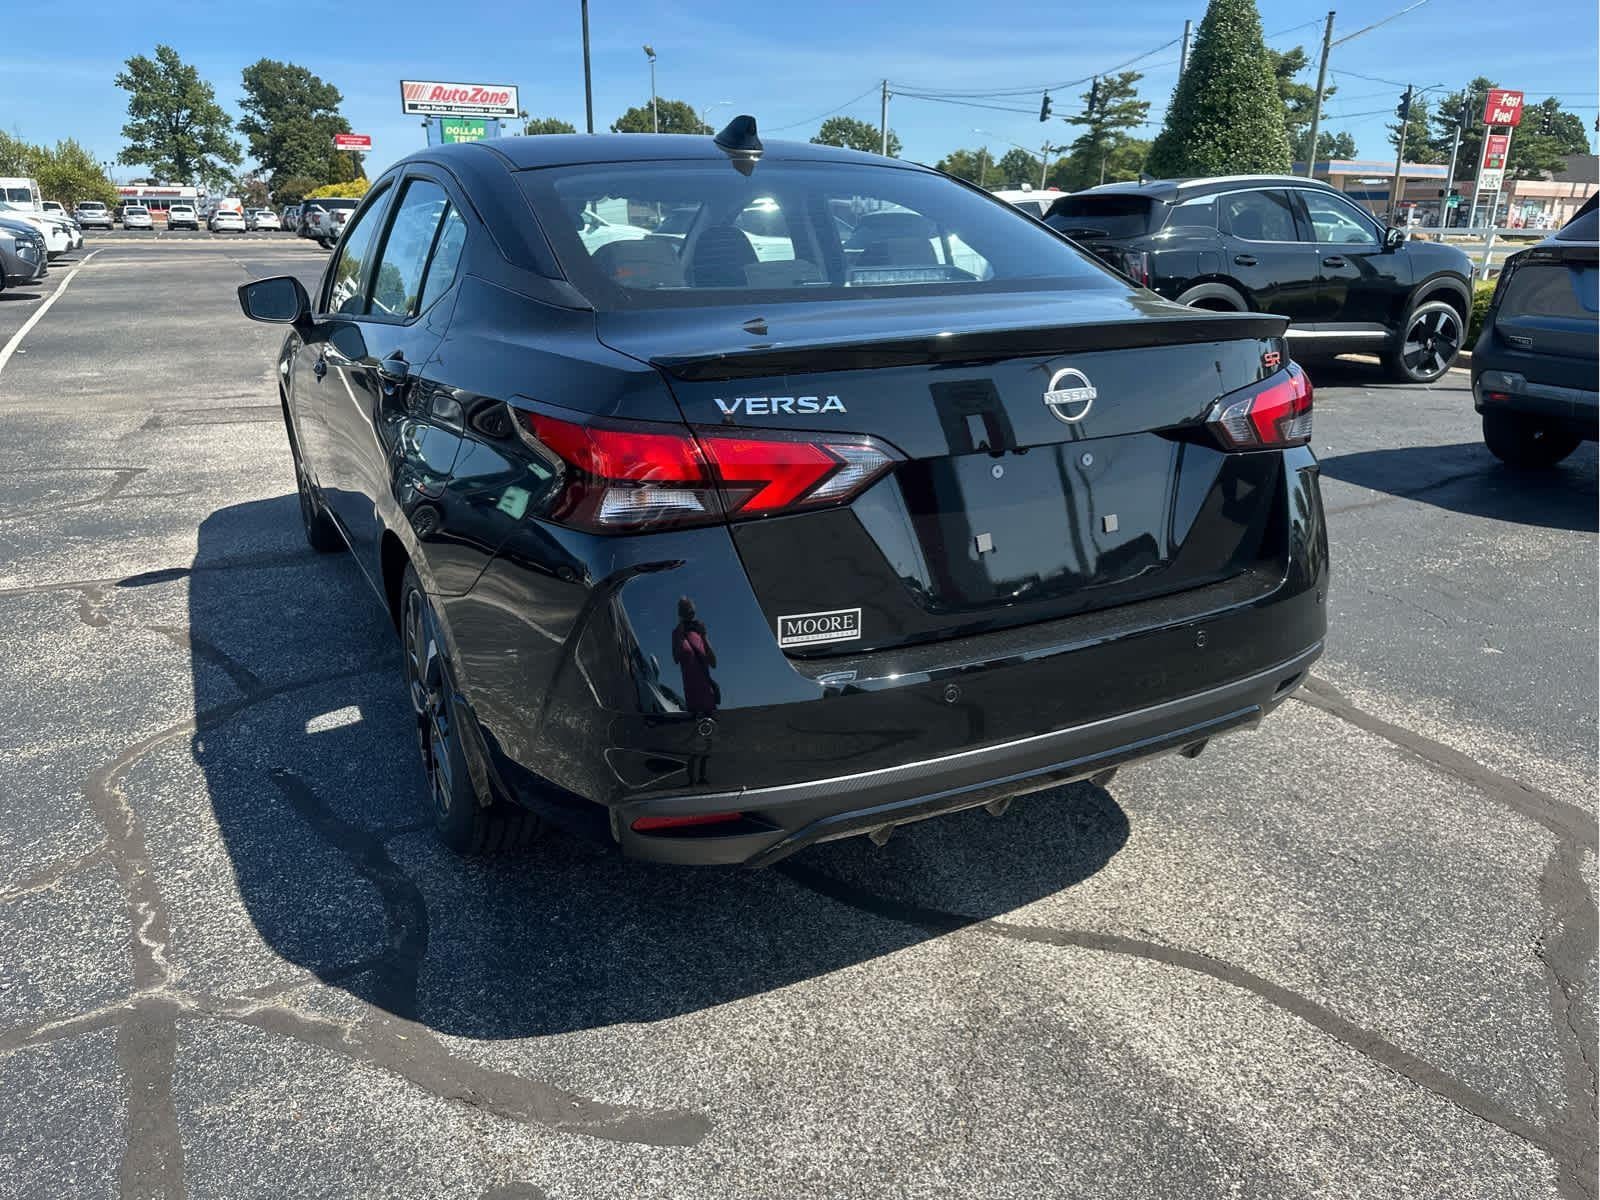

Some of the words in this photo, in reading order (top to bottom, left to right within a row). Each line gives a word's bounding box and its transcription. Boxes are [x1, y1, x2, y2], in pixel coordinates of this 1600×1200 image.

[429, 85, 509, 104] AutoZone
[1500, 93, 1522, 108] Fast
[1492, 108, 1514, 123] Fuel
[445, 126, 485, 136] DOLLAR
[1264, 351, 1280, 367] SR
[1044, 388, 1097, 404] NISSAN
[713, 395, 848, 415] VERSA
[787, 614, 855, 636] MOORE
